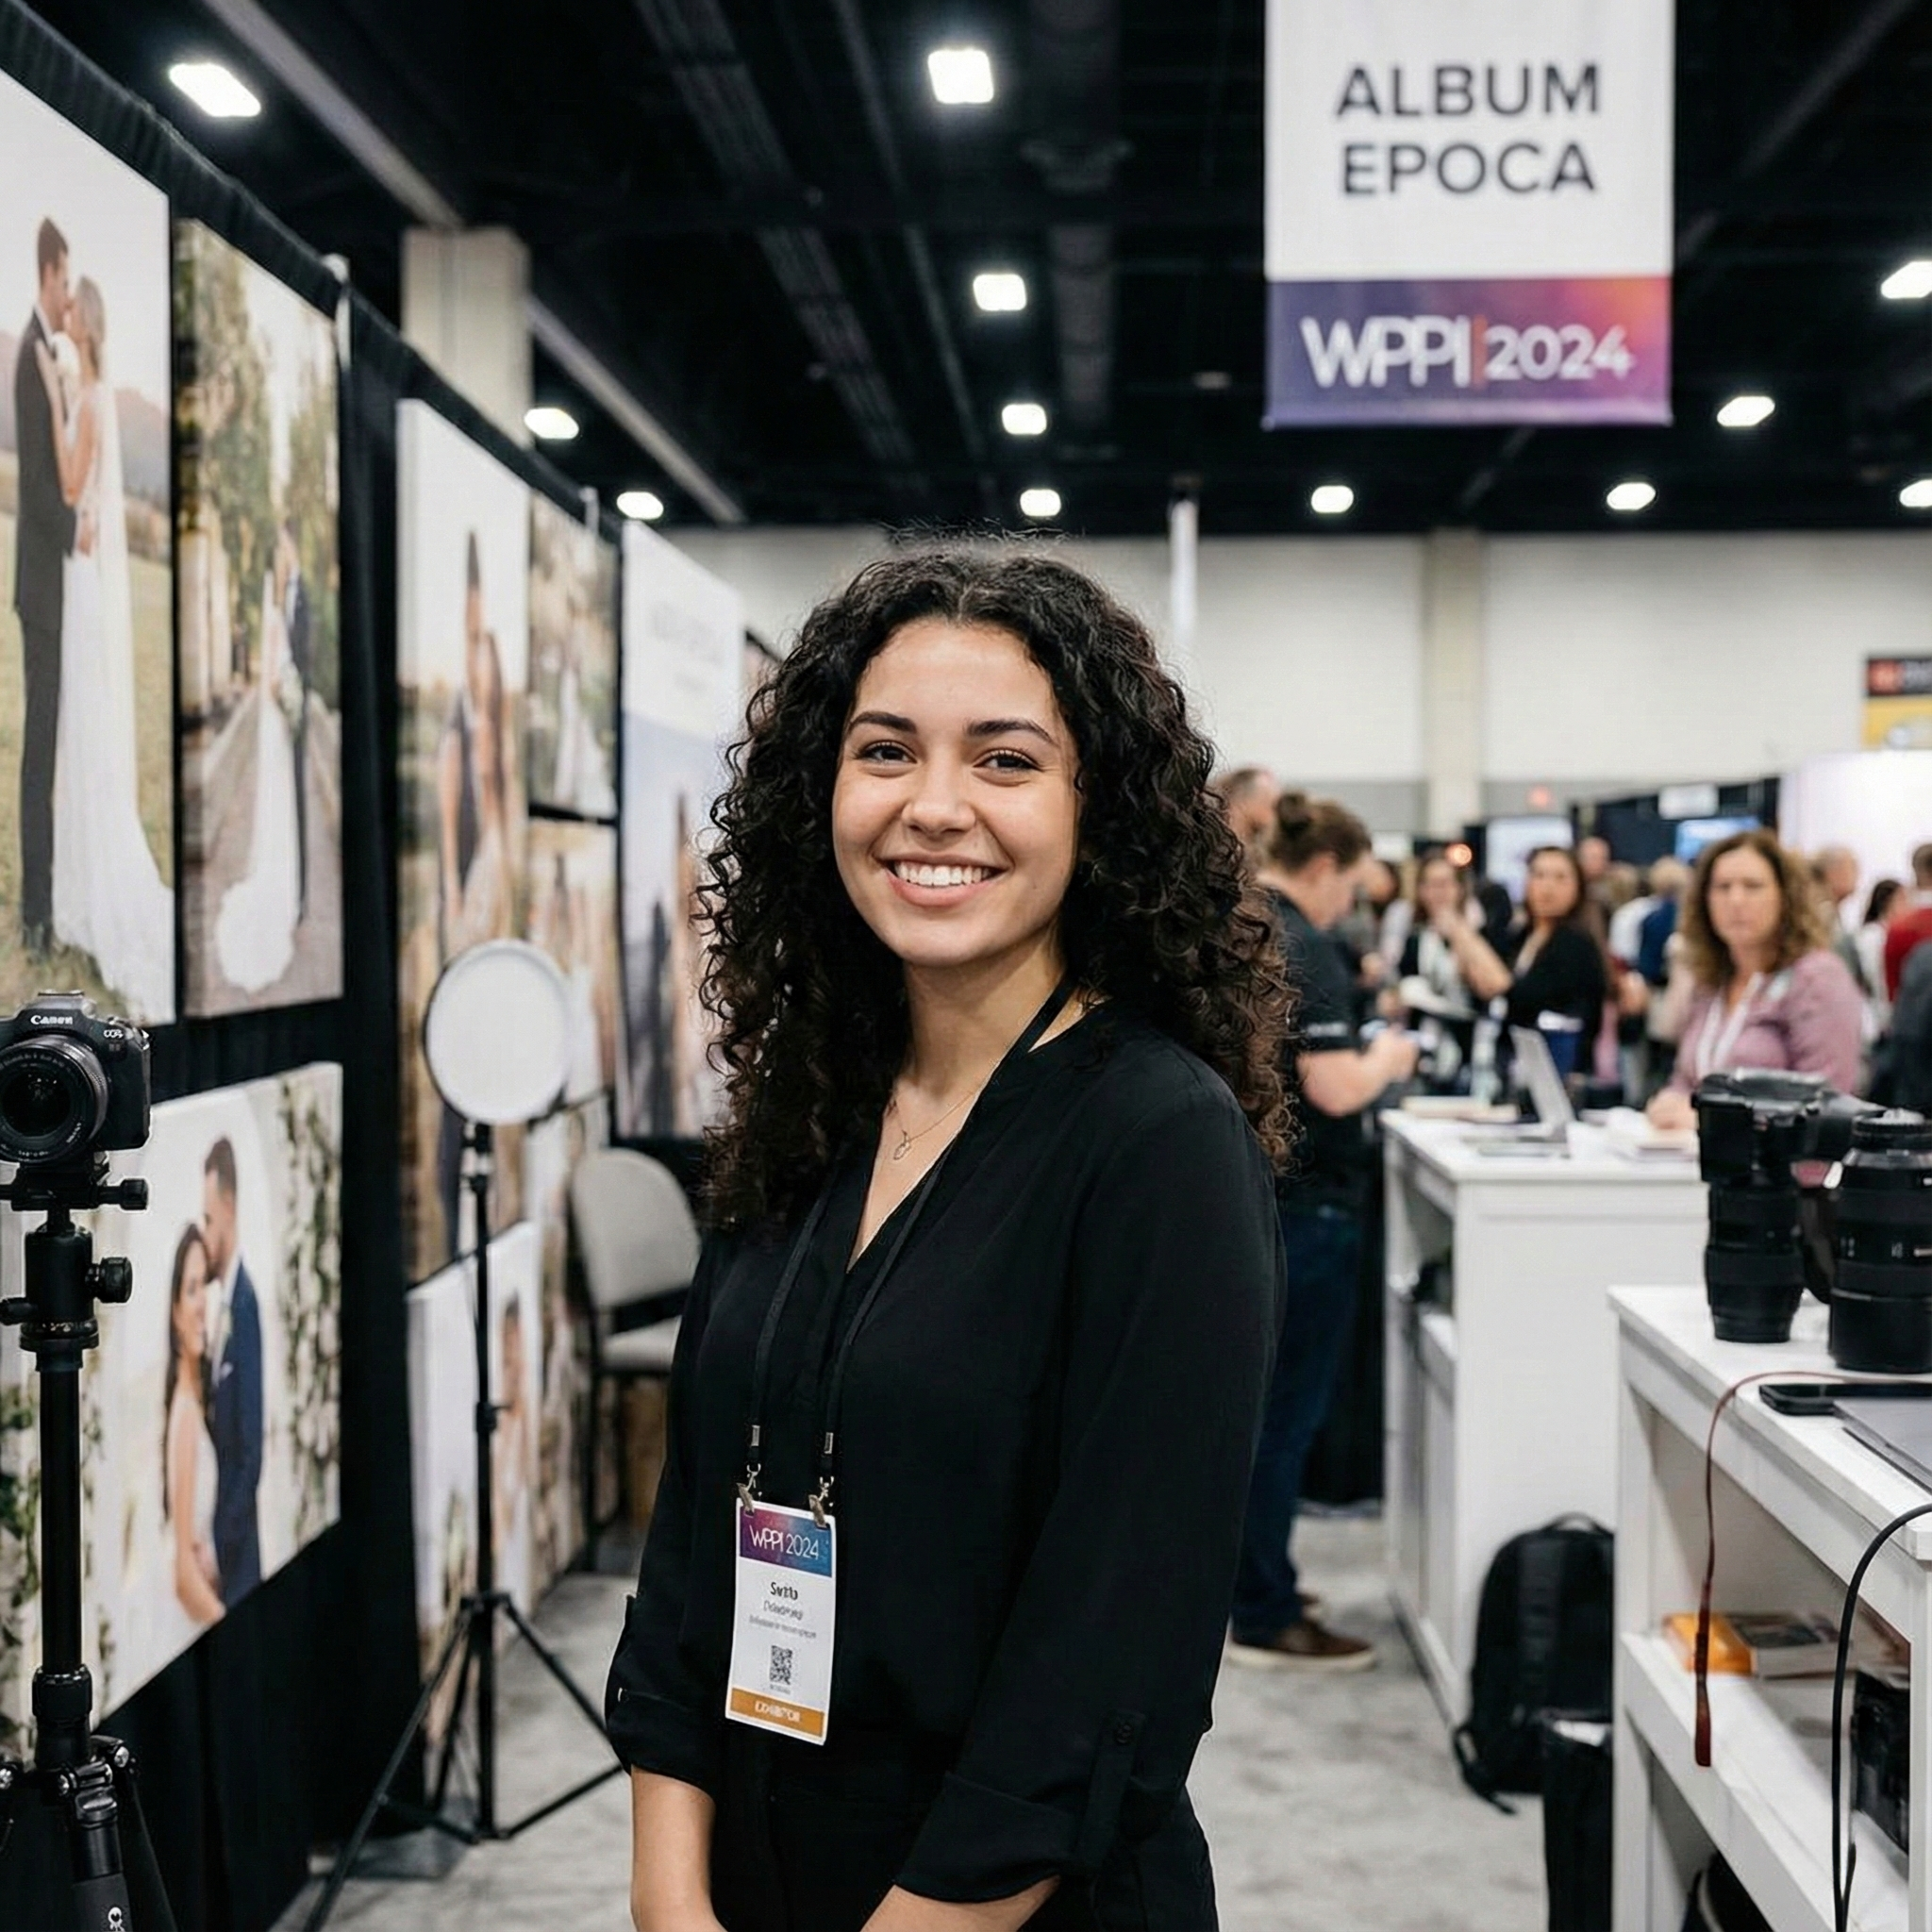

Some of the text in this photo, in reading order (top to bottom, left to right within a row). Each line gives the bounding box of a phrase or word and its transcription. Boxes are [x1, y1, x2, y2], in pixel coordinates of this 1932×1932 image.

[1335, 64, 1599, 116] ALBUM
[1342, 141, 1595, 194] EPOCA
[1301, 314, 1636, 389] WPPI 2024
[749, 1524, 819, 1560] WPPI 2024
